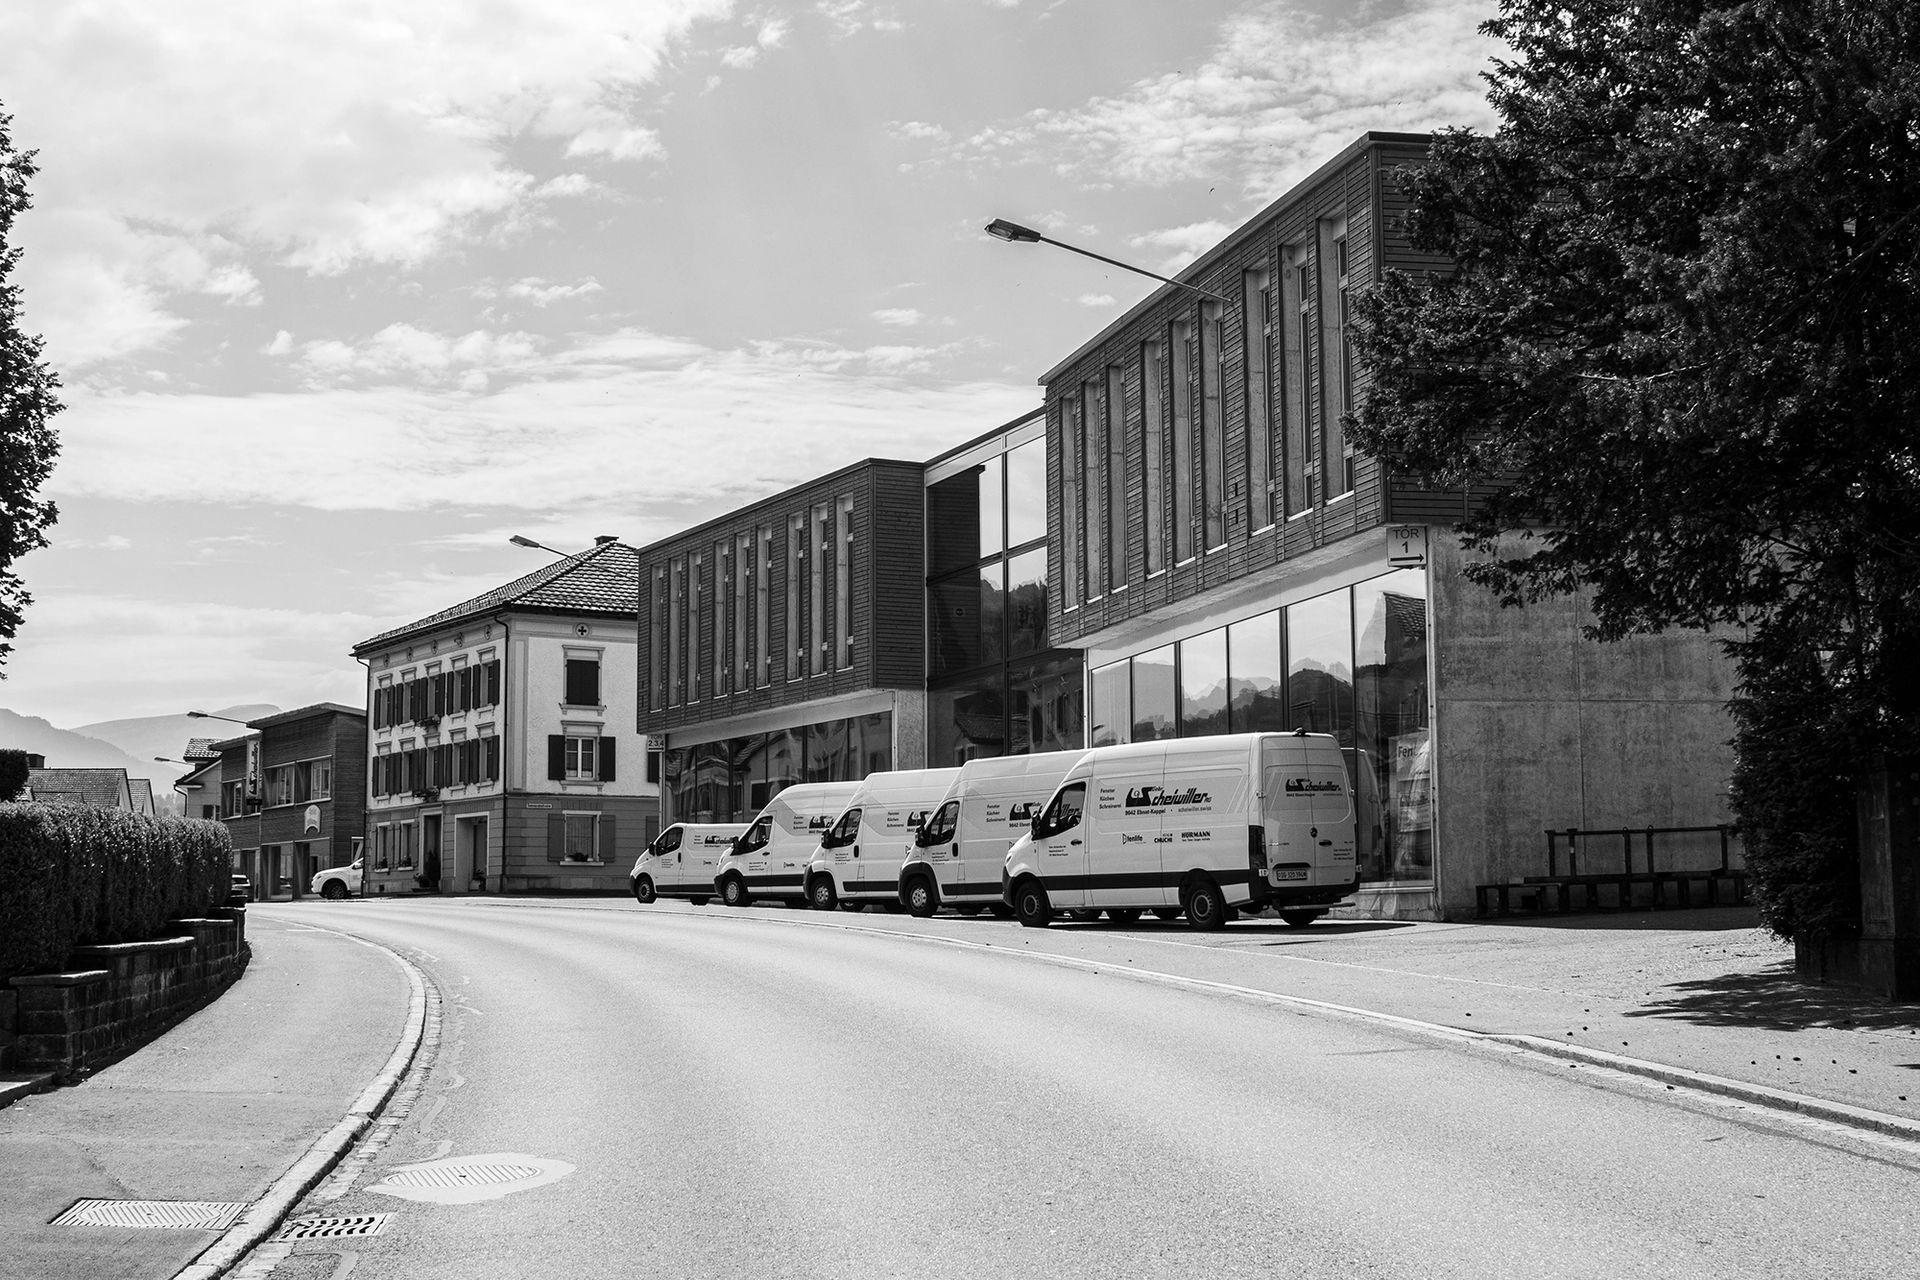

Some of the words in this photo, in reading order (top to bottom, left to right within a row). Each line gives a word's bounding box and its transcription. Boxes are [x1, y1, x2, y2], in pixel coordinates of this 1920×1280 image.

[1392, 528, 1419, 539] TOR
[1401, 541, 1408, 554] 1
[1140, 786, 1208, 807] Scheiwiller
